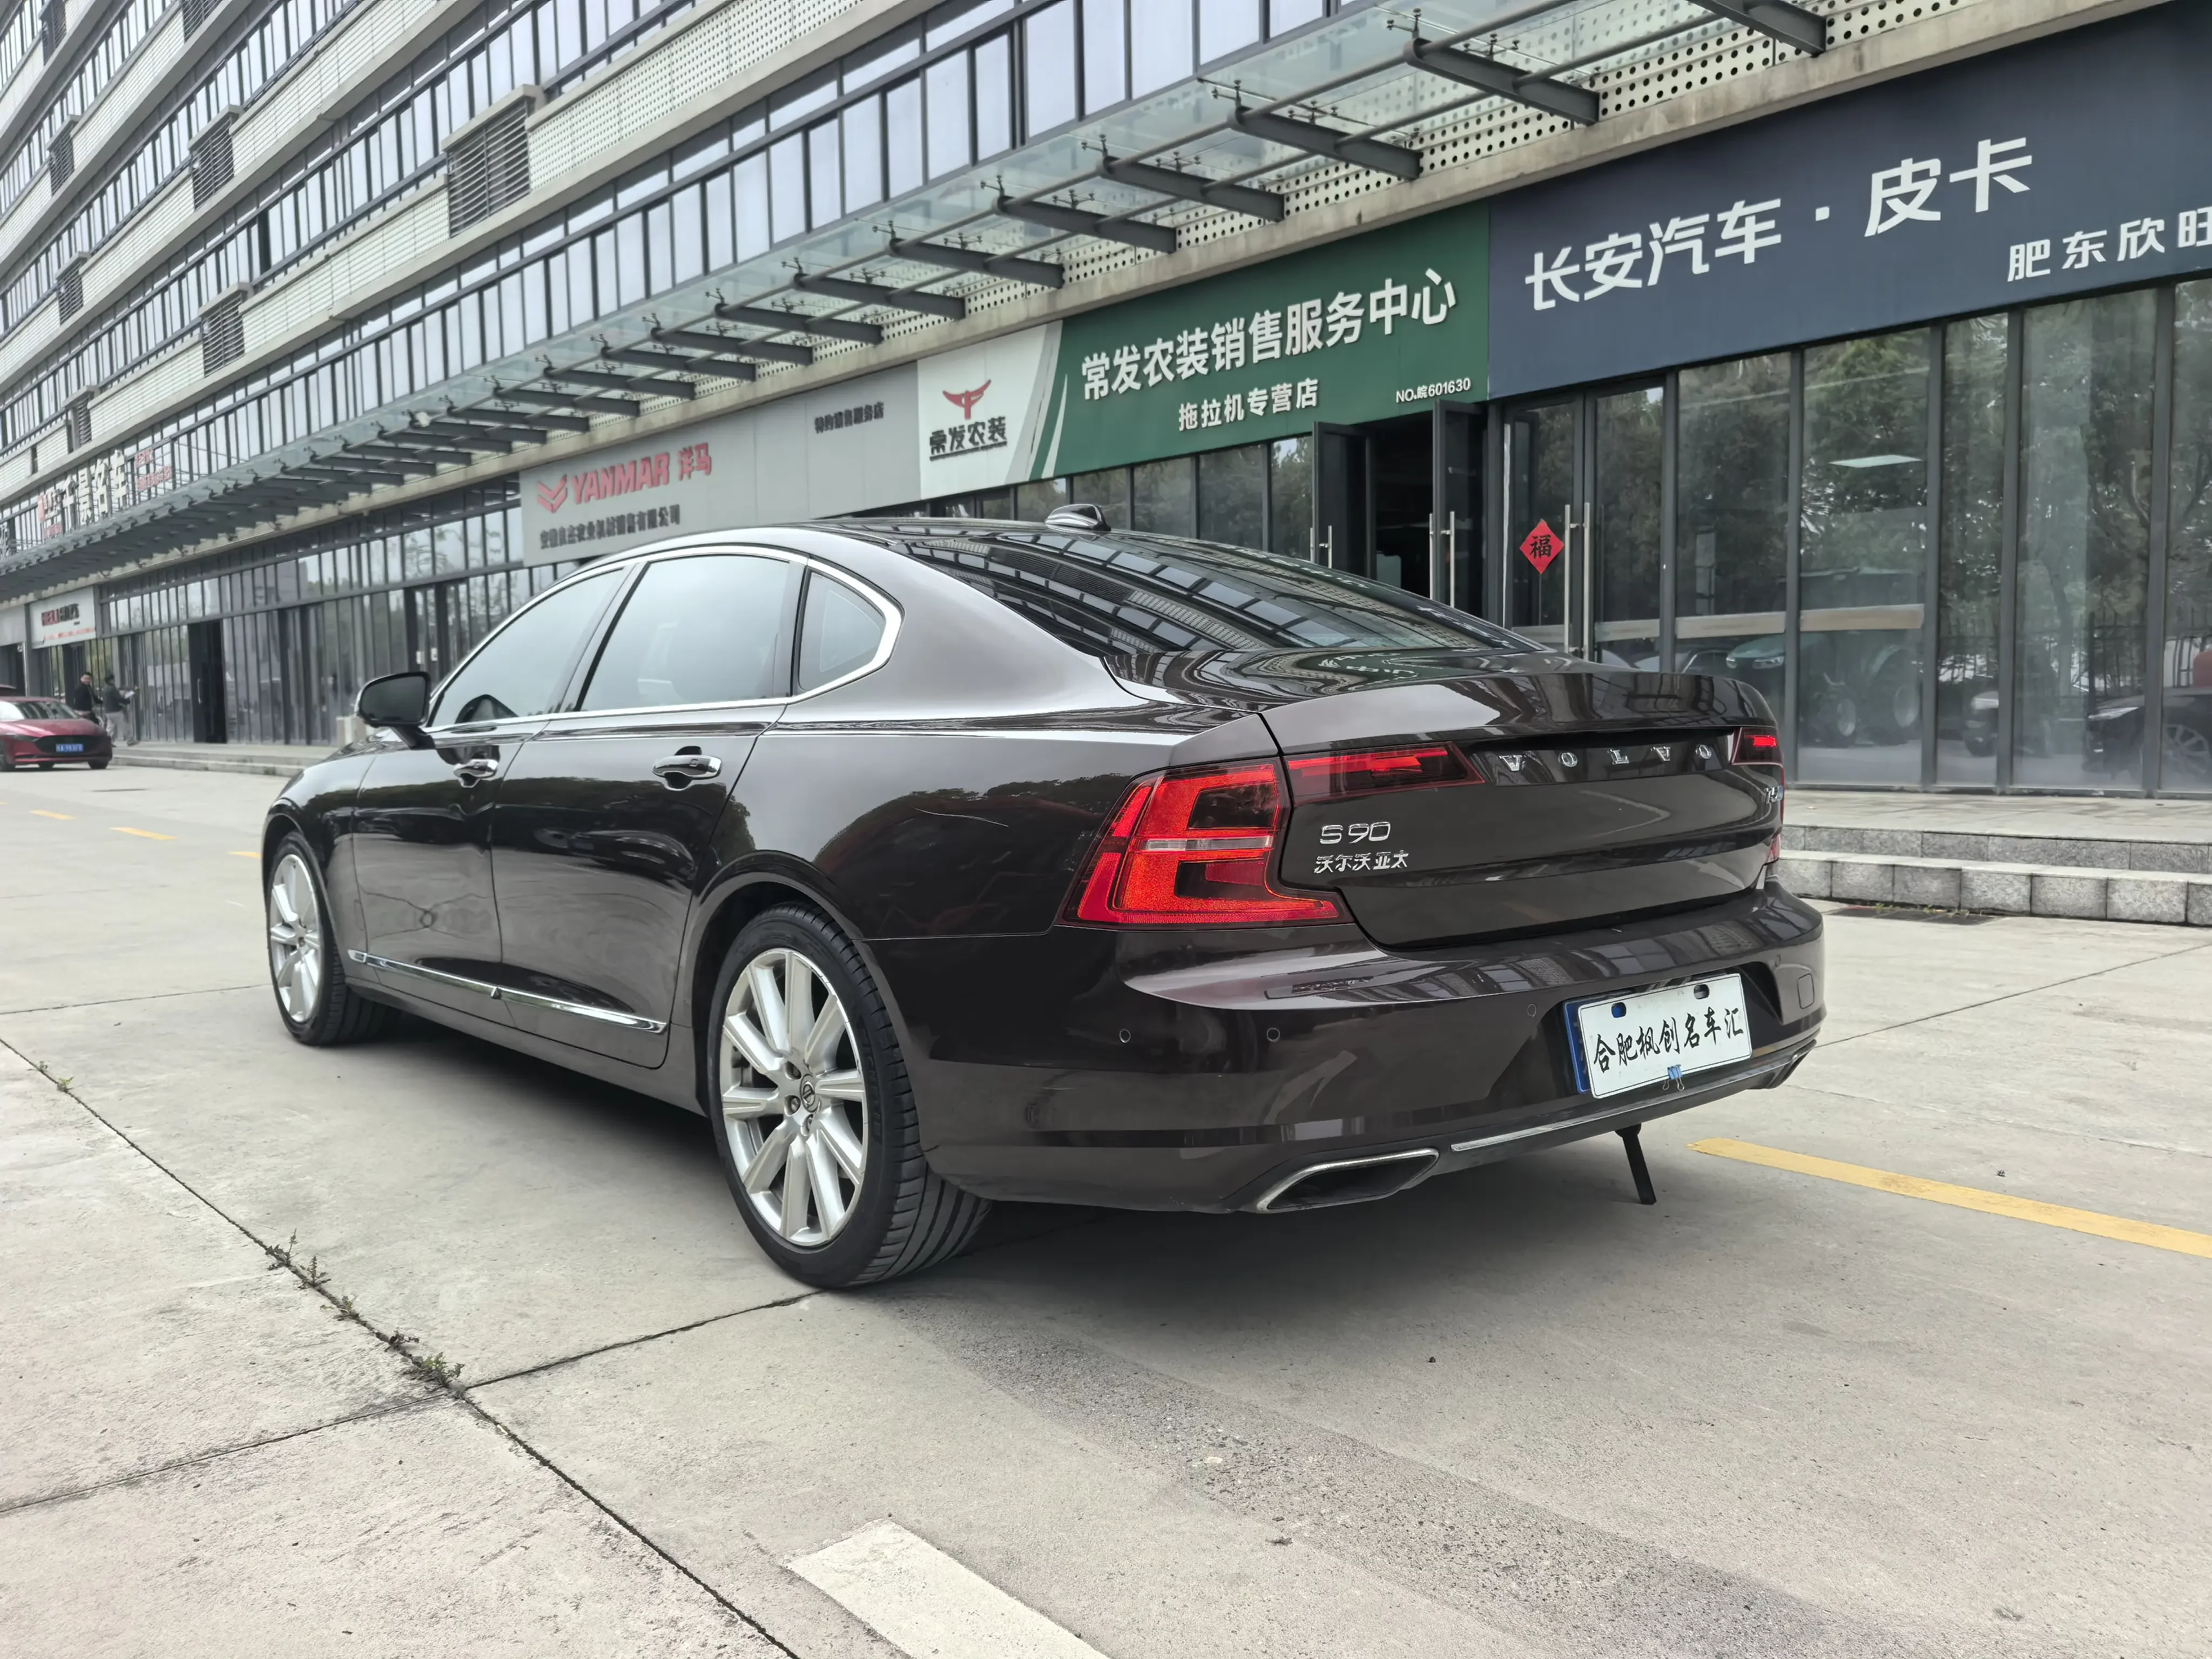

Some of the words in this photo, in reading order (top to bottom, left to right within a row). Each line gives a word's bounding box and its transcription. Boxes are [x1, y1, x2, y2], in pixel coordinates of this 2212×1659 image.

[2007, 204, 2212, 282] 肥东欣旺
[1081, 268, 1458, 400] 常发农装销售服务中心
[1178, 379, 1319, 432] 拖拉机专营店
[929, 416, 1007, 455] 常发农装
[571, 453, 670, 504] YANMAR
[678, 443, 712, 481] 洋马
[1529, 534, 1552, 558] 福
[1498, 744, 1712, 772] VOLVO
[1314, 850, 1409, 874] 沃尔沃亚太
